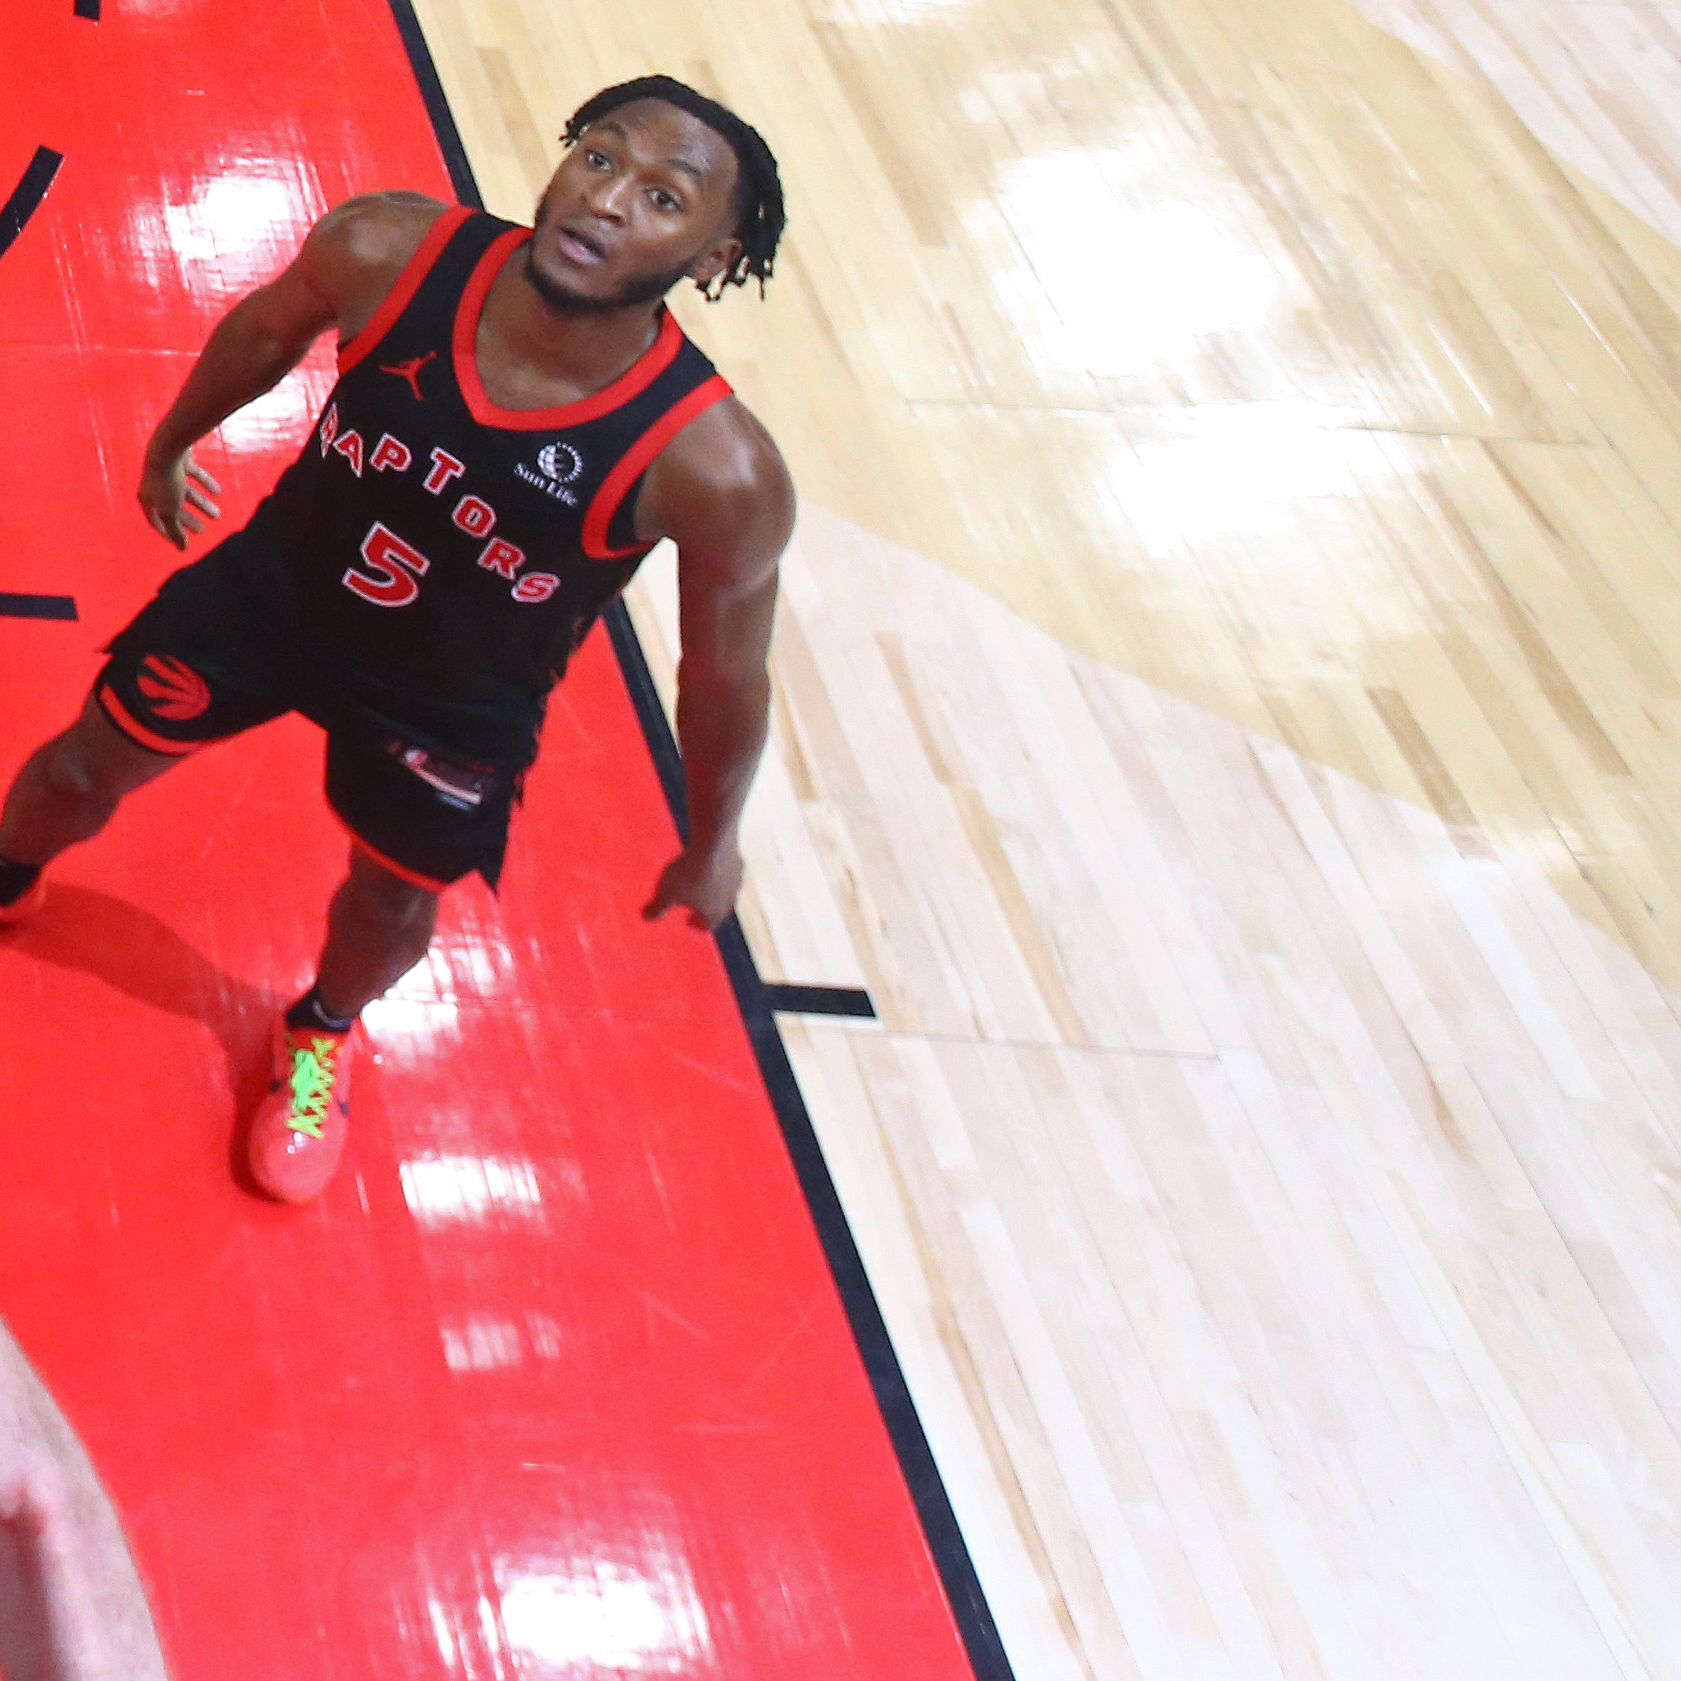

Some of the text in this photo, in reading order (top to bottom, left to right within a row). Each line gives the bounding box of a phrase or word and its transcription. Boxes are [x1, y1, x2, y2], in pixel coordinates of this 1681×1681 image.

[319, 401, 562, 604] RAPTORS
[513, 462, 579, 507] Sun Life
[341, 520, 432, 608] 5
